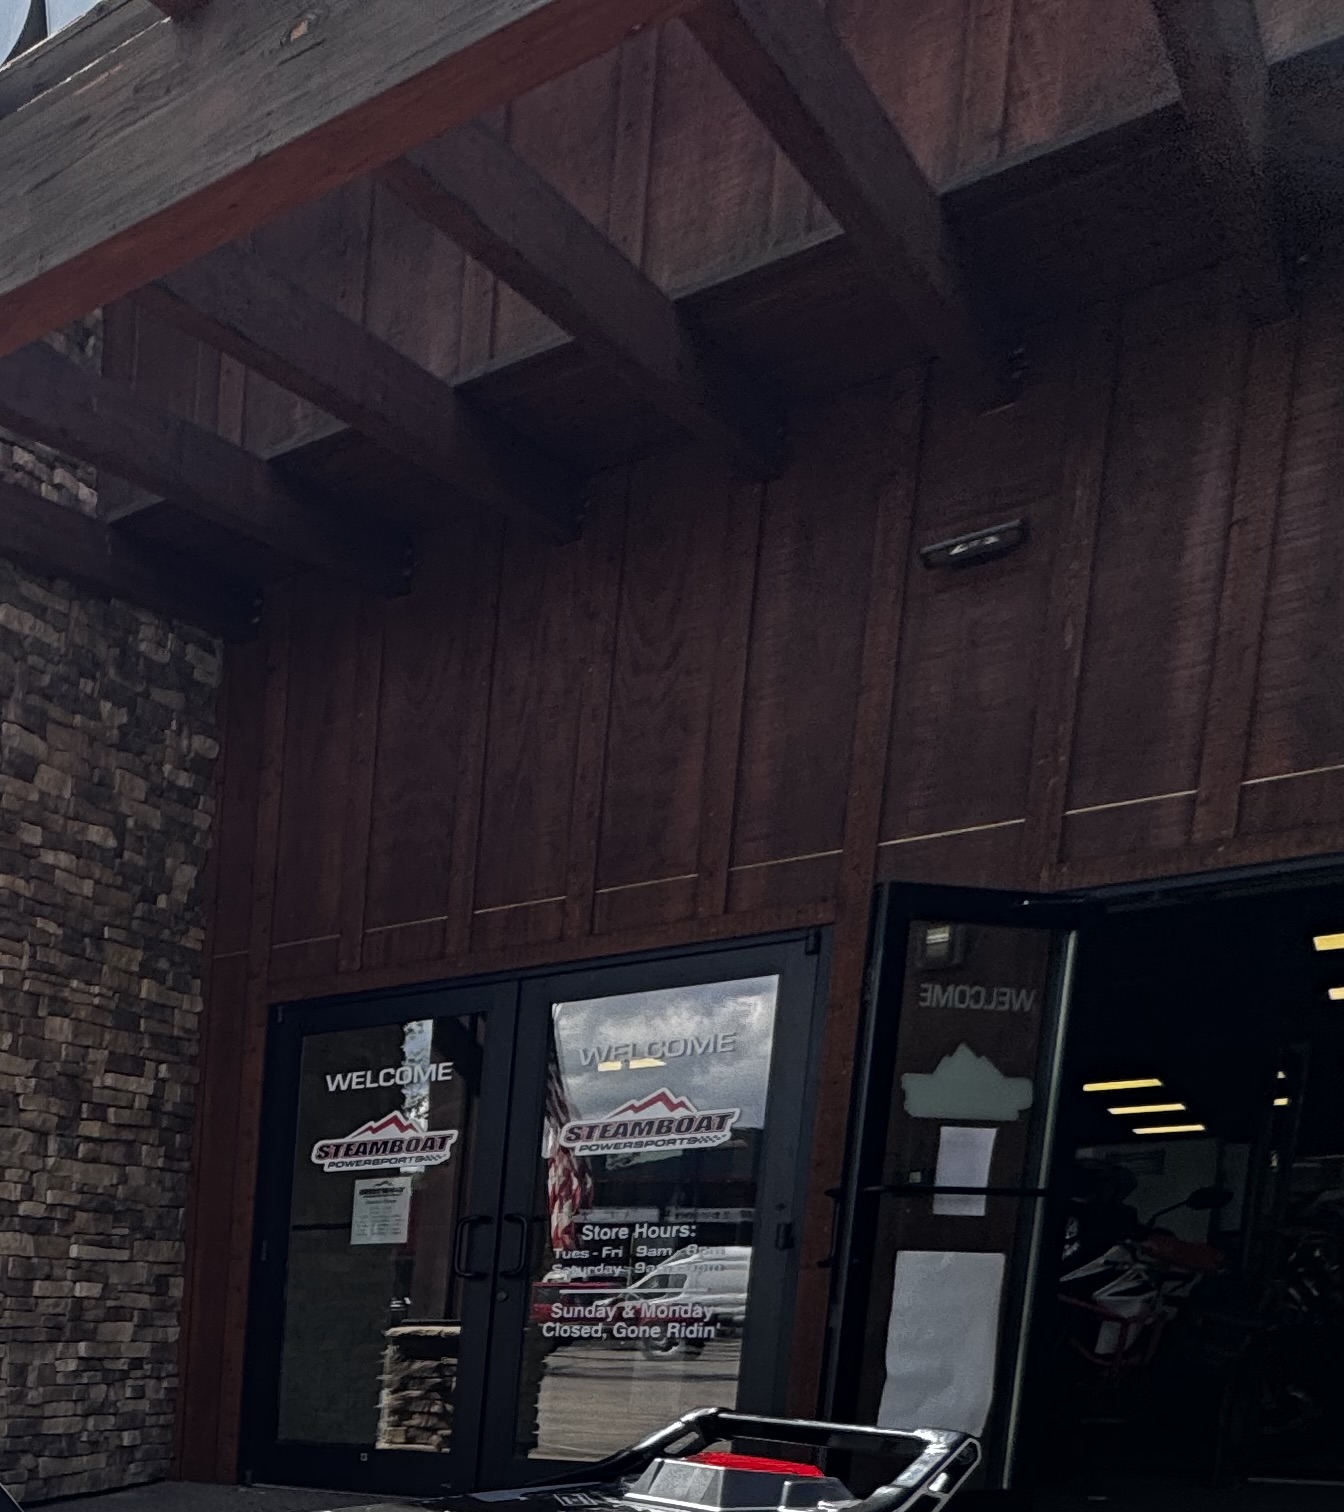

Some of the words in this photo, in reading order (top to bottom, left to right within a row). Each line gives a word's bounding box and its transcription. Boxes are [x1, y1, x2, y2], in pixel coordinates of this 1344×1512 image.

[578, 1032, 737, 1066] WELCOME
[326, 1062, 454, 1092] WELCOME
[566, 1112, 736, 1143] STEAMBOAT
[315, 1133, 455, 1161] STEAMBOAT
[579, 1137, 698, 1152] POWERSPORTS
[327, 1155, 426, 1169] POWERSPORTS
[581, 1225, 629, 1241] Store
[634, 1223, 697, 1239] Hours:
[553, 1248, 590, 1260] Tues
[602, 1245, 623, 1258] Fri
[636, 1246, 672, 1258] 9am
[551, 1262, 621, 1277] Saturday
[550, 1303, 615, 1321] Sunday
[622, 1305, 636, 1318] &
[640, 1303, 713, 1321] Monday
[542, 1322, 607, 1340] Closed,
[613, 1323, 661, 1338] Gone
[666, 1322, 721, 1339] Ridin'
